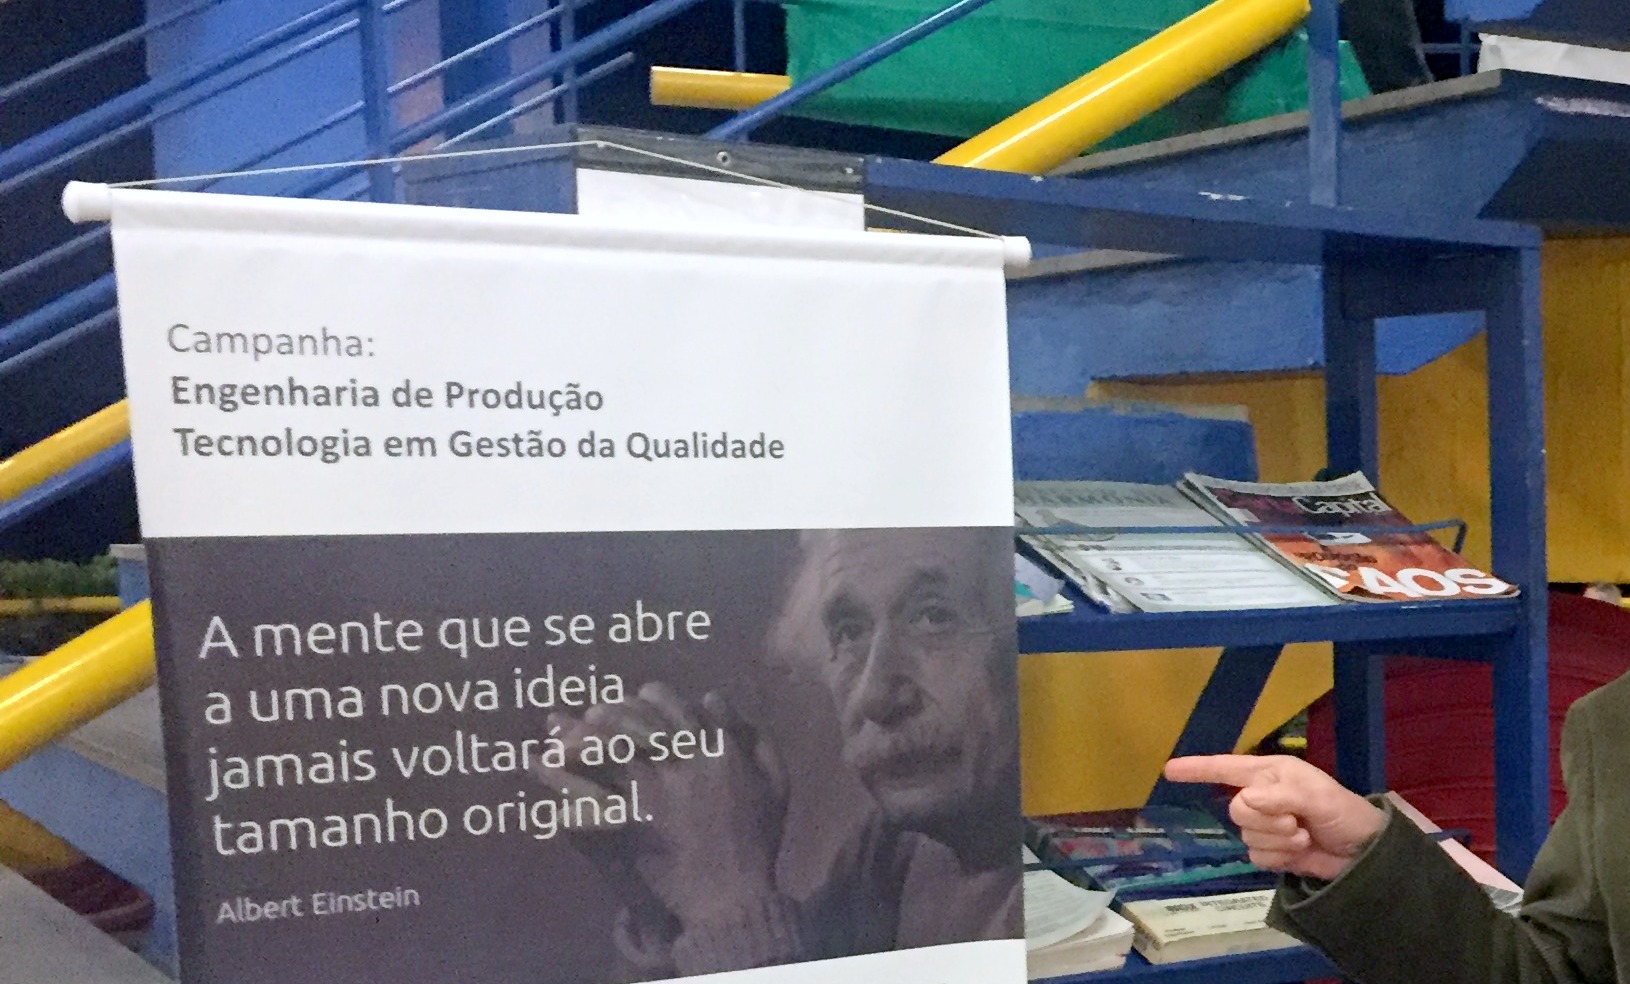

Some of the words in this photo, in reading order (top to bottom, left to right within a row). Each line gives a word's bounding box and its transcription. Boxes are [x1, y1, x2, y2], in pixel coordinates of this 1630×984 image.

[167, 323, 375, 362] Campanha:
[171, 375, 380, 413] Engenharia
[391, 378, 434, 409] de
[445, 380, 604, 417] Produção
[172, 426, 372, 465] Tecnologia
[383, 436, 437, 458] em
[448, 429, 567, 458] Gestão
[577, 430, 615, 459] da
[626, 431, 785, 462] Qualidade
[198, 615, 240, 660] A
[253, 611, 424, 657] mente
[438, 616, 531, 659] que
[543, 614, 595, 646] se
[608, 599, 711, 643] abre
[204, 691, 233, 725] a
[249, 685, 364, 723] uma
[380, 679, 500, 716] nova
[514, 663, 625, 709] ideia
[204, 739, 377, 802] jamais
[391, 724, 568, 778] voltará
[580, 733, 636, 766] ao
[648, 728, 725, 762] seu
[213, 800, 448, 856] tamanho
[463, 781, 654, 840] original.
[216, 895, 304, 924] Albert
[311, 888, 421, 915] Einstein
